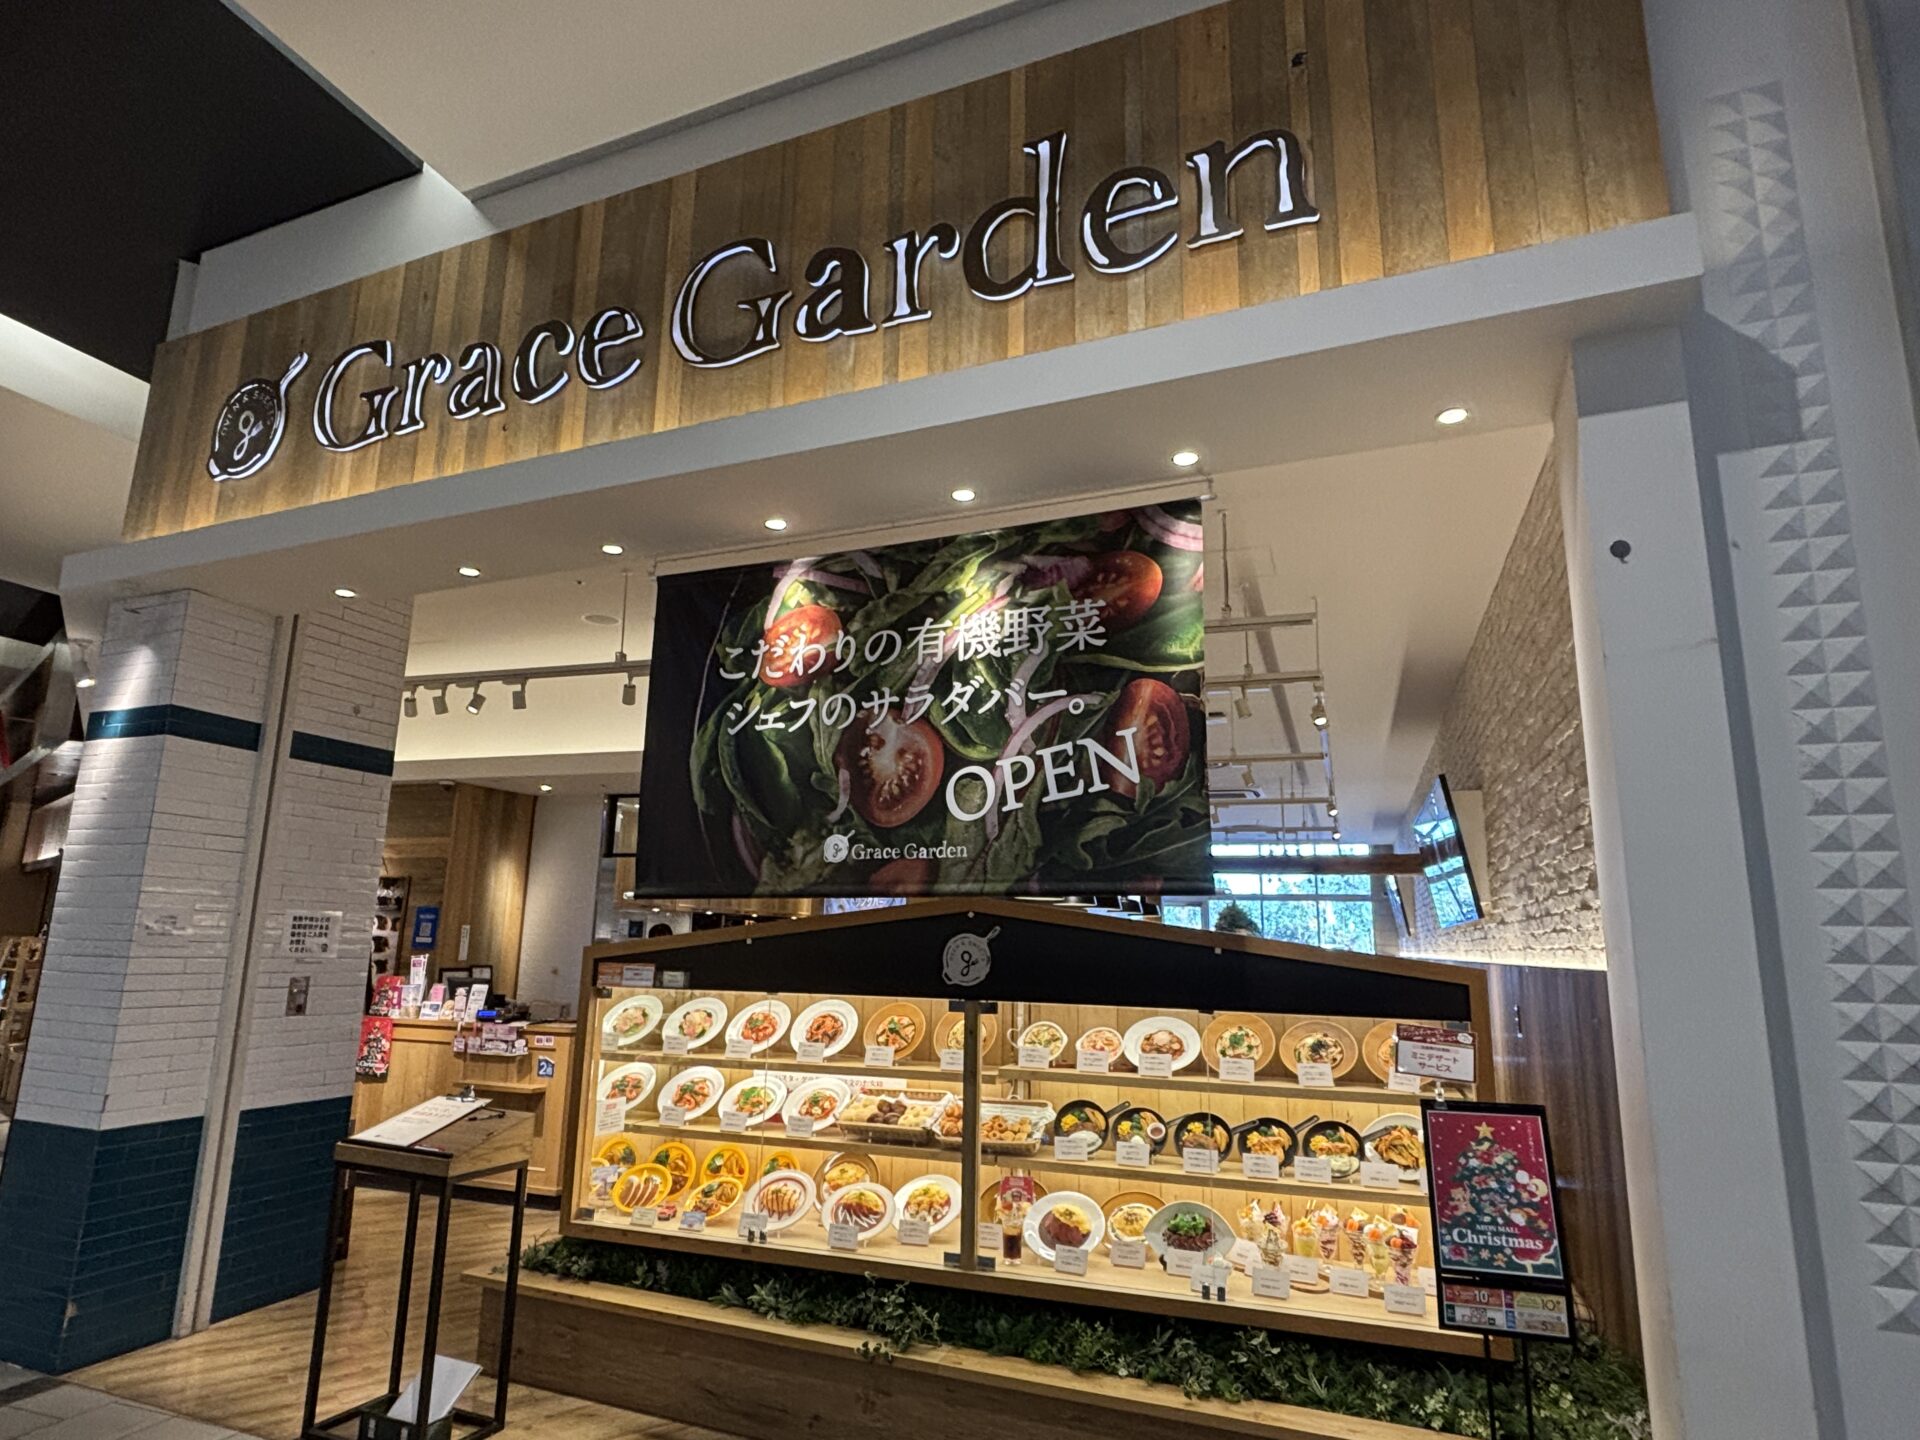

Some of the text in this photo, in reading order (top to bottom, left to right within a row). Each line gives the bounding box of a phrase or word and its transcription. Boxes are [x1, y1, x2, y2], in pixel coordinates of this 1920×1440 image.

[313, 129, 1321, 452] Grace Garden
[718, 598, 1108, 681] こだわりの有機野菜
[725, 675, 1086, 736] シェフのサラダバー。
[945, 726, 1142, 822] OPEN
[851, 840, 968, 861] Grace Garden
[1418, 1062, 1453, 1073] サービス
[1452, 1227, 1544, 1250] Christmas
[1498, 1225, 1520, 1234] MALL
